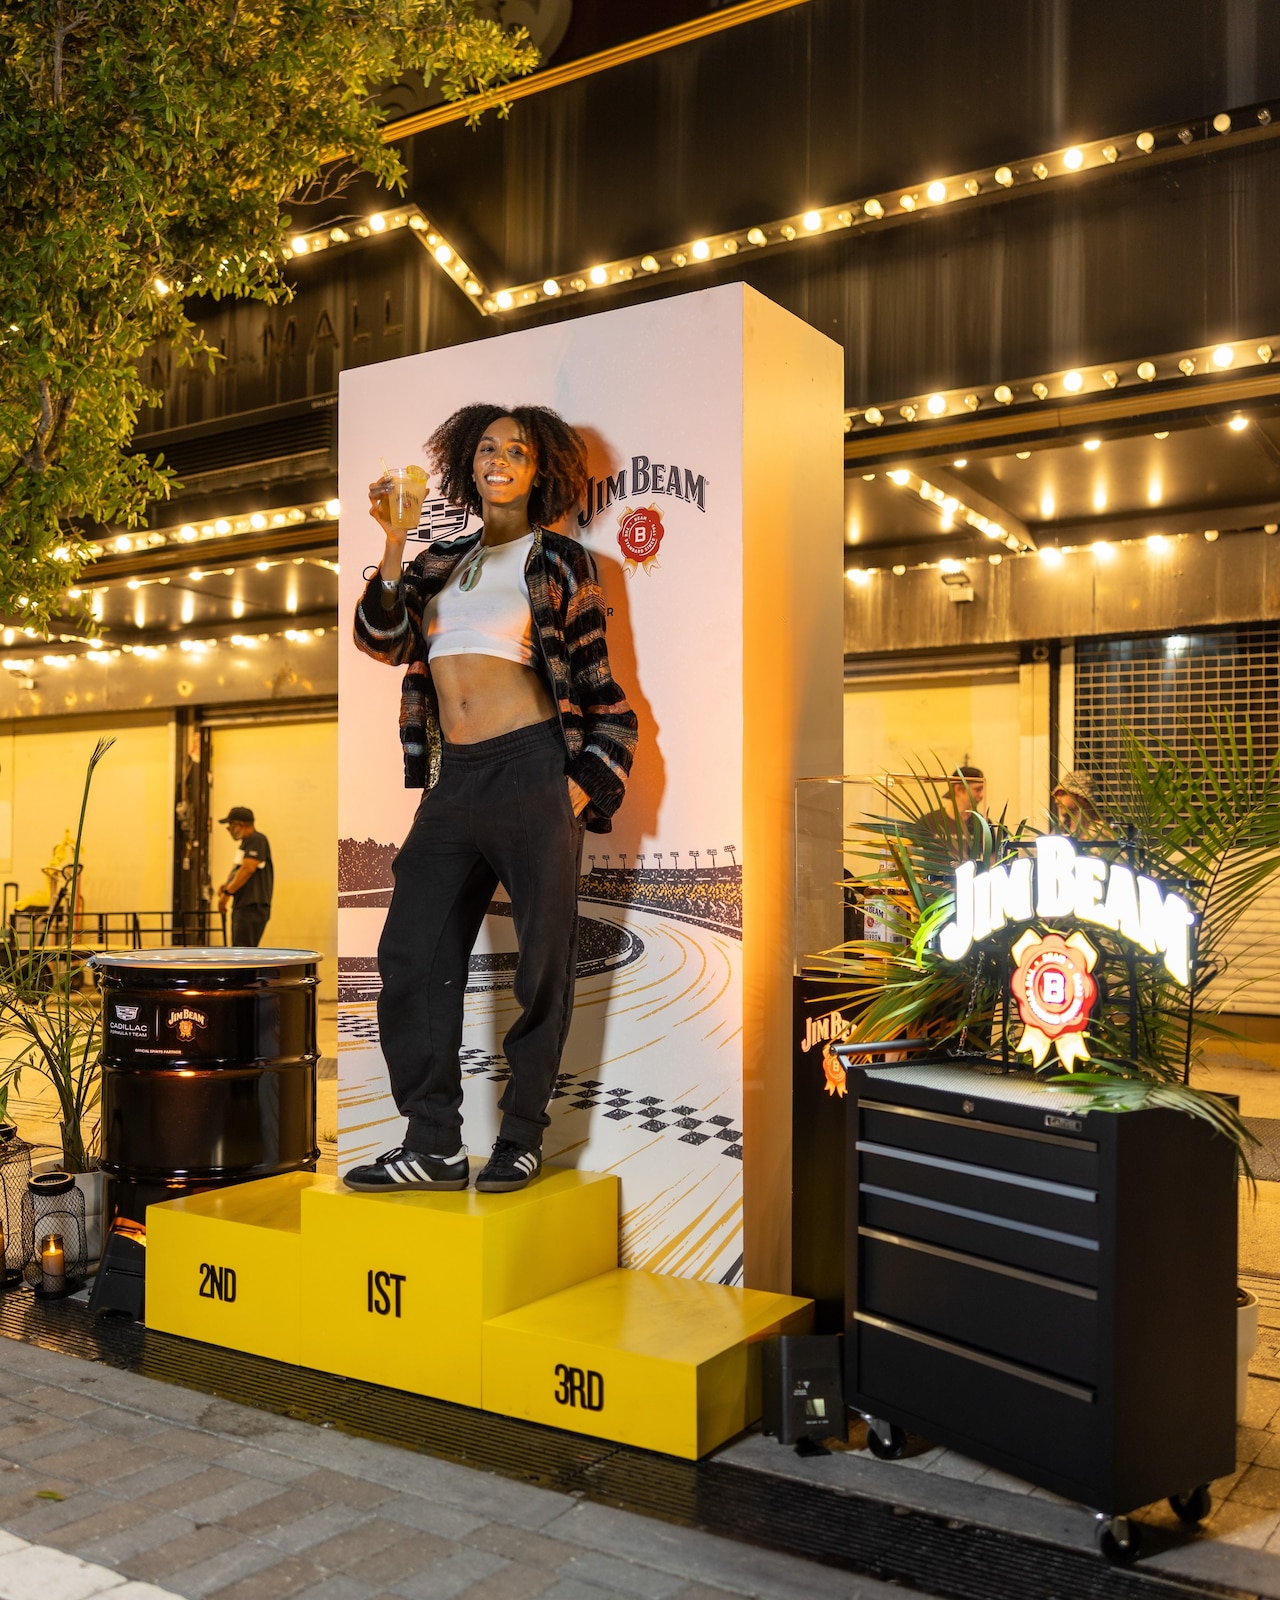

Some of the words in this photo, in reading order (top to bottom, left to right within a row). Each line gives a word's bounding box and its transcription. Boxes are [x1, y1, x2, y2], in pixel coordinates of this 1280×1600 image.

[263, 292, 403, 360] MALL
[577, 470, 627, 528] JIM
[631, 455, 706, 513] BEAM
[635, 527, 646, 542] B
[939, 860, 1034, 962] JIM
[1036, 835, 1190, 987] BEAM
[1043, 972, 1066, 1004] B
[110, 1021, 148, 1032] CADILLAC
[168, 1011, 183, 1025] JIM
[183, 1008, 206, 1026] BEAM
[801, 1017, 830, 1053] JIM
[199, 1263, 237, 1304] 2ND
[367, 1269, 407, 1319] 1ST
[554, 1363, 605, 1412] 3RD
